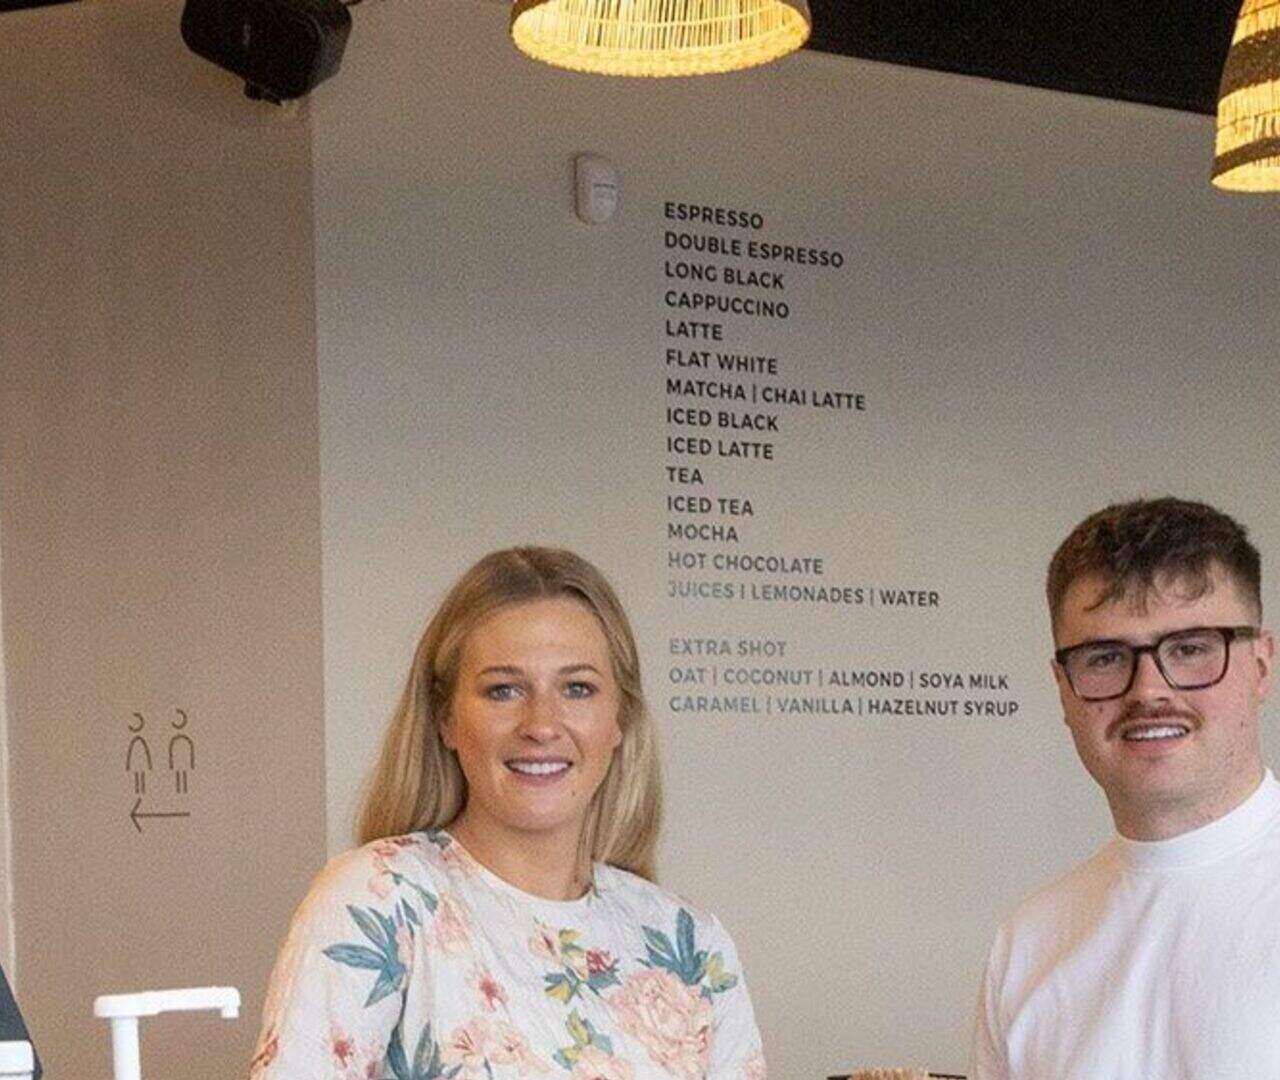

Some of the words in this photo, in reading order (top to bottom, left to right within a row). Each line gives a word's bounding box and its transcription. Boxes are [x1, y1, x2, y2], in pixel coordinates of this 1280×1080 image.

[665, 201, 764, 230] ESPRESSO
[665, 230, 741, 257] DOUBLE
[747, 241, 845, 269] ESPRESSO
[665, 261, 717, 283] LONG
[723, 267, 784, 290] BLACK
[665, 290, 790, 319] CAPPUCCINO
[666, 319, 723, 342] LATTE
[667, 348, 711, 368] FLAT
[716, 353, 778, 375] WHITE
[667, 378, 747, 401] MATCHA
[761, 386, 807, 406] CHAI
[811, 390, 866, 411] LATTE
[667, 407, 712, 427] ICED
[717, 410, 779, 432] BLACK
[668, 436, 712, 456] ICED
[718, 440, 774, 461] LATTE
[666, 466, 704, 485] TEA
[668, 495, 713, 514] ICED
[717, 498, 754, 516] TEA
[668, 523, 739, 543] MOCHA
[669, 552, 707, 569] HOT
[714, 553, 823, 575] CHOCOLATE
[670, 581, 734, 599] JUICES
[751, 584, 864, 605] LEMONADES
[879, 589, 940, 608] WATER
[670, 638, 731, 655] EXTRA
[737, 640, 786, 657] SHOT
[670, 667, 706, 684] OAT
[723, 668, 813, 685] COCONUT
[828, 670, 905, 688] ALMOND
[919, 672, 964, 689] SOYA
[969, 674, 1009, 690] MILK
[670, 696, 760, 713] CARAMEL
[777, 698, 854, 714] VANILLA
[868, 699, 959, 716] HAZELNUT
[963, 700, 1019, 717] SYRUP
